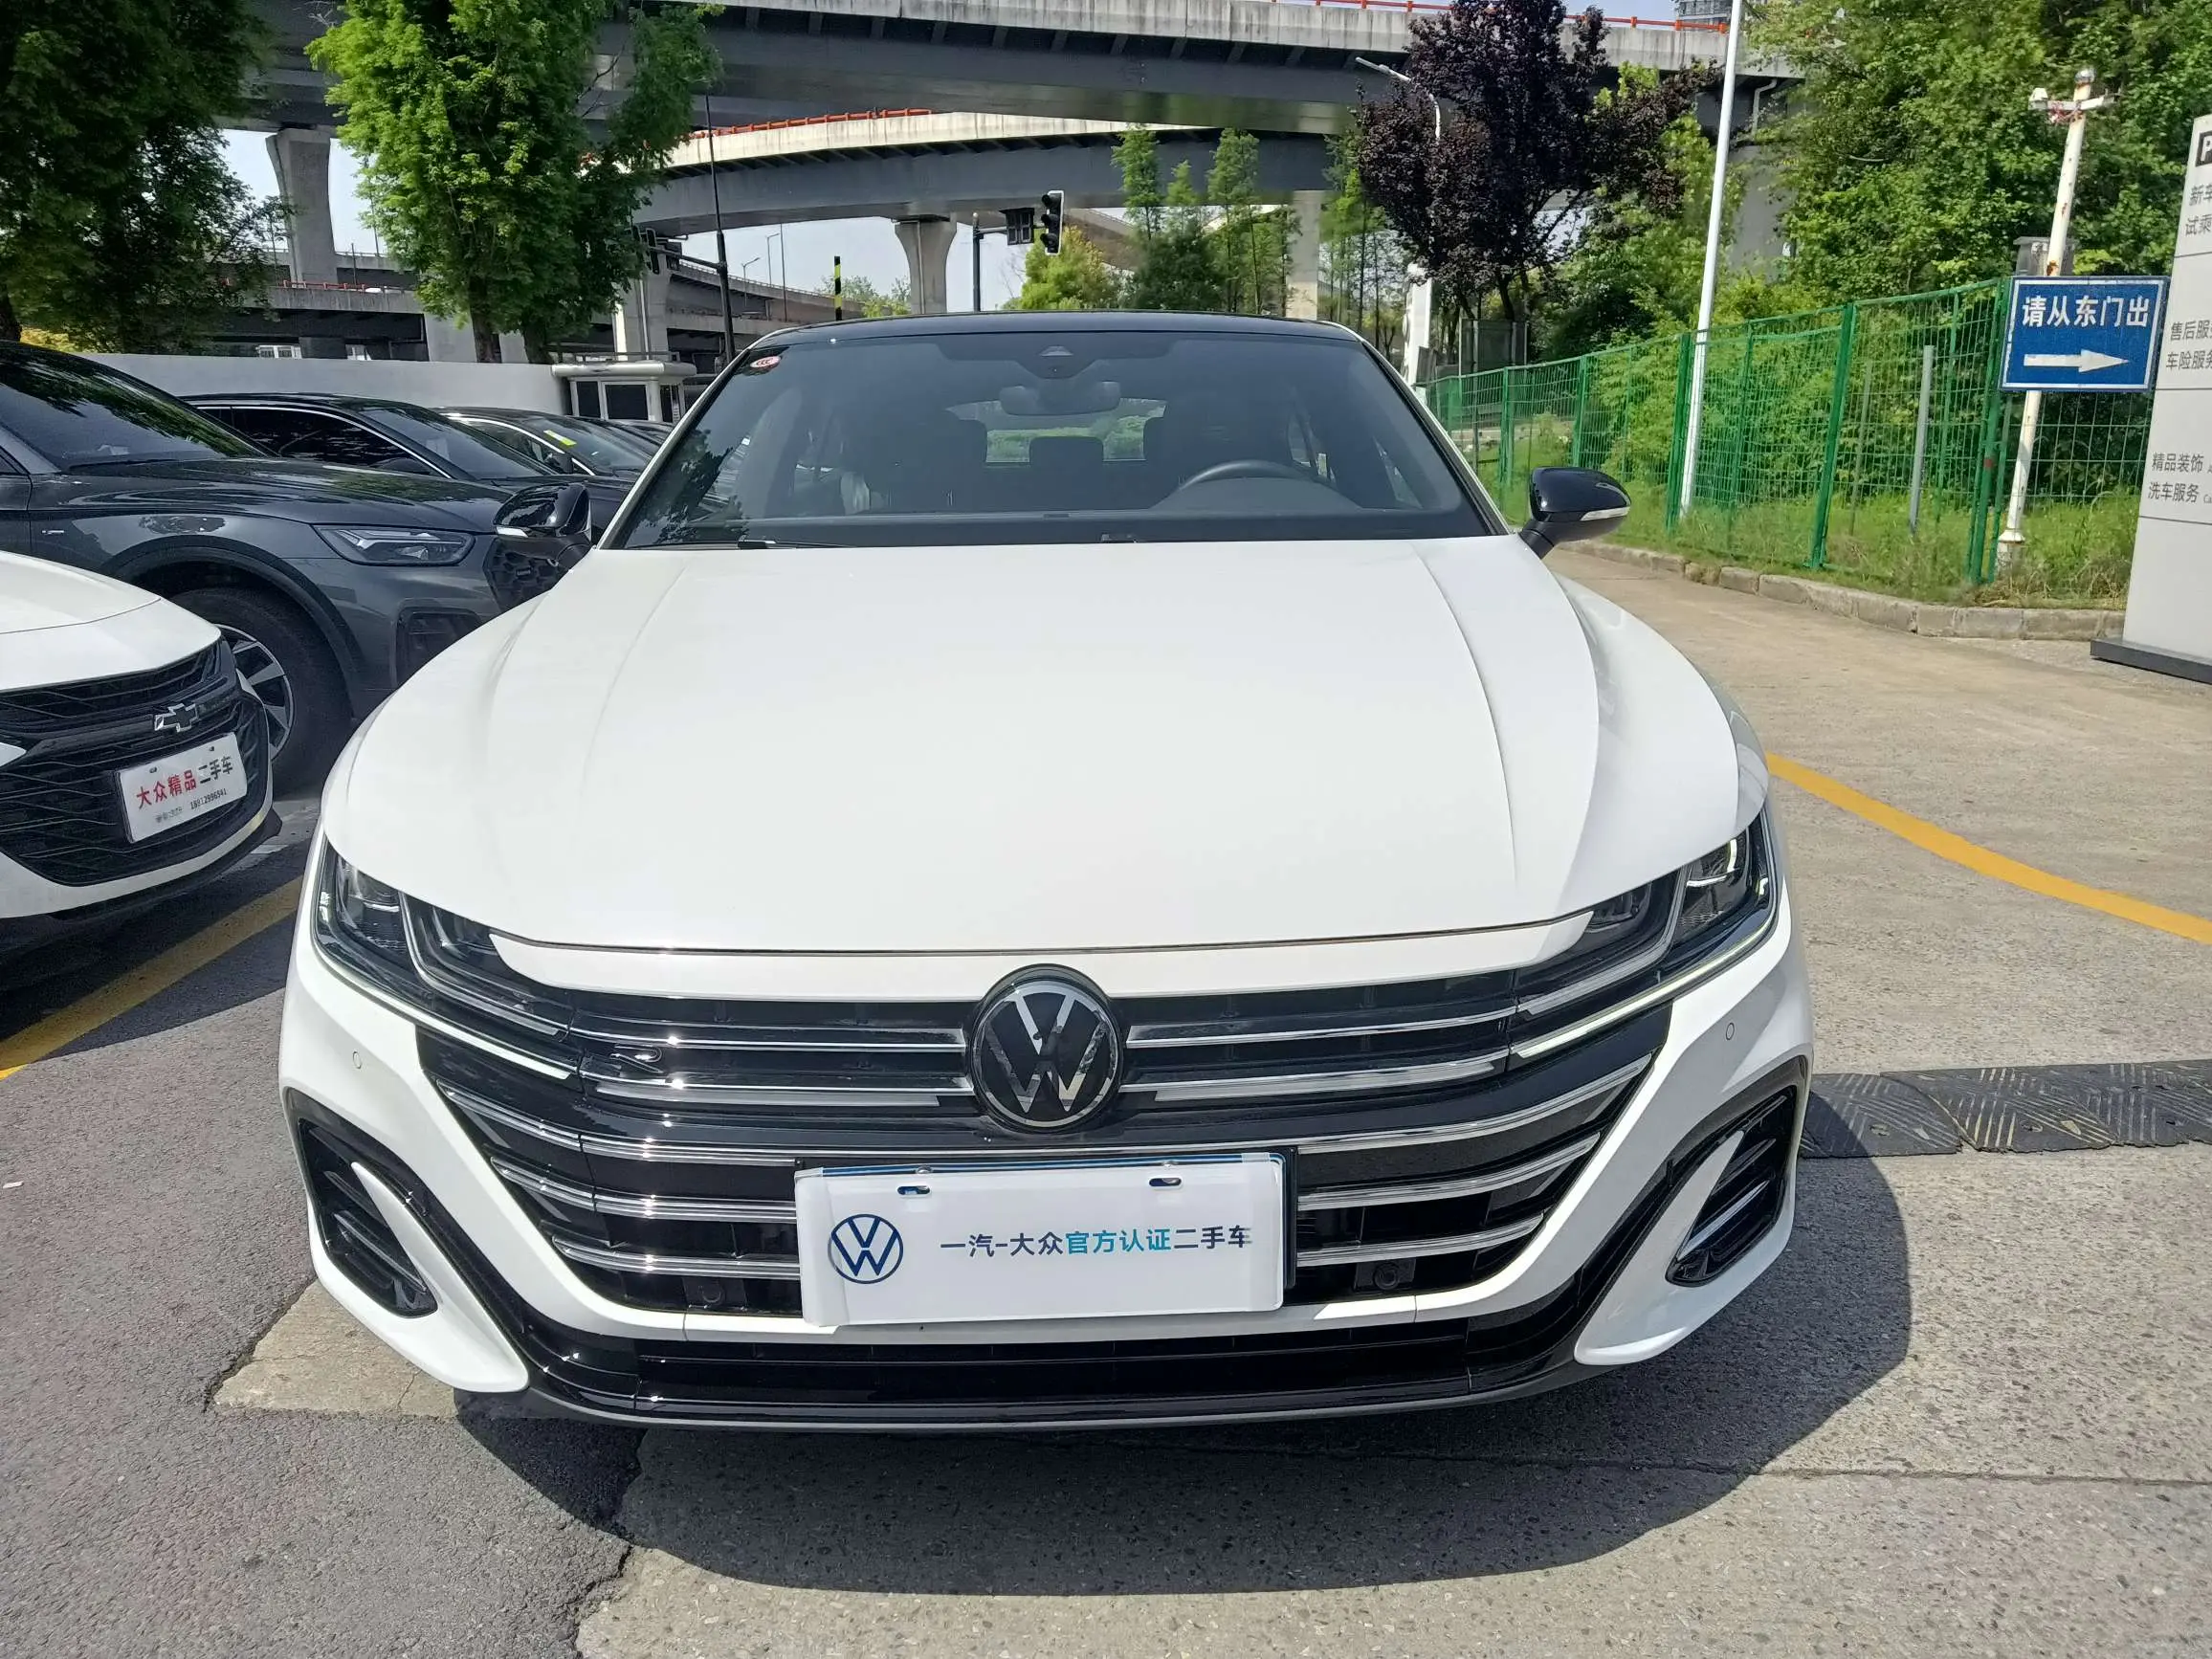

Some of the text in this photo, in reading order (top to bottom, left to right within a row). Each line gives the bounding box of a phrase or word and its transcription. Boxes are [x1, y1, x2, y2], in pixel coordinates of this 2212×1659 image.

[2022, 295, 2149, 327] 请从东门出
[2170, 319, 2212, 341] 售后服
[2152, 452, 2204, 473] 精品装饰
[2148, 481, 2200, 503] 洗车服务
[940, 1225, 1252, 1257] 一汽-大众官方认证二手车
